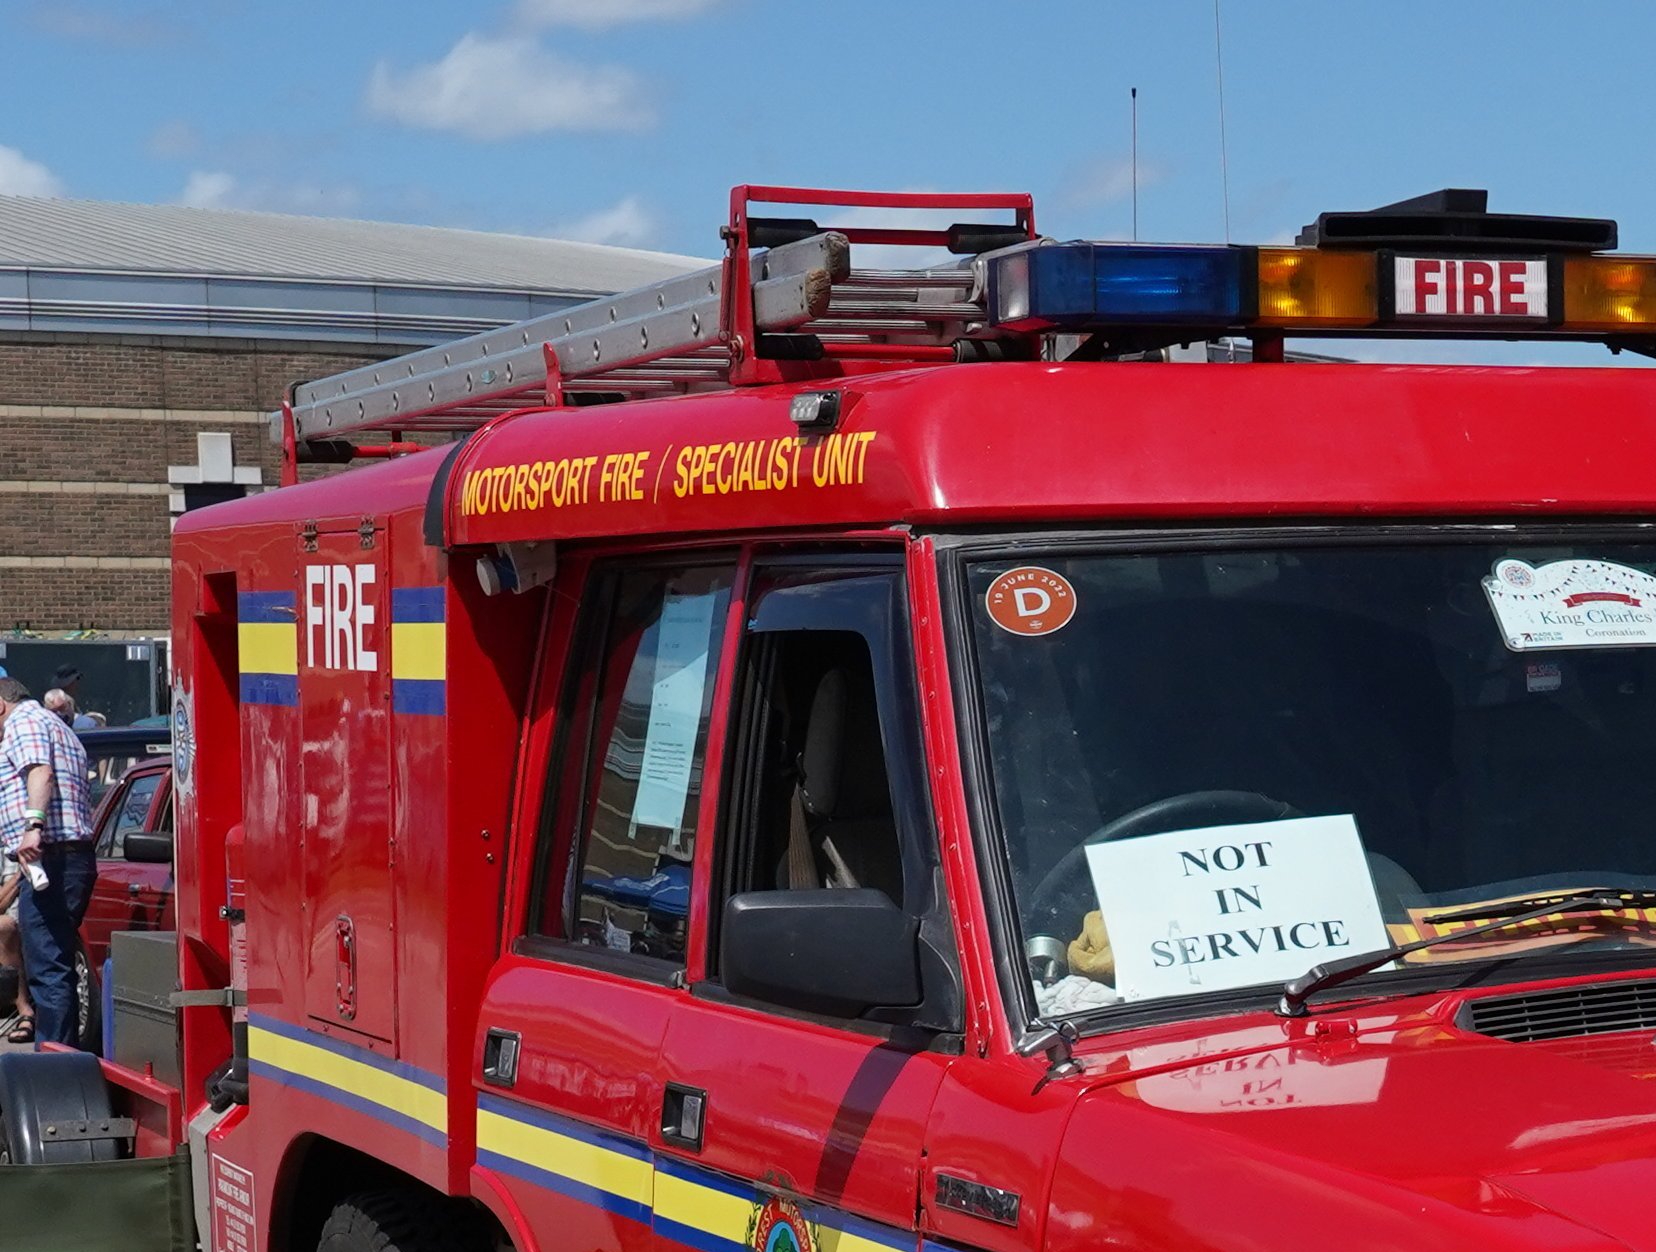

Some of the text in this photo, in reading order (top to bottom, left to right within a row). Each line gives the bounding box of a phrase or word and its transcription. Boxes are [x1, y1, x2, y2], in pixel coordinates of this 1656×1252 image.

[1415, 260, 1528, 314] FIRE
[462, 456, 598, 516] MOTORSPORT
[599, 451, 650, 502] FIRE
[673, 436, 809, 498] SPECIALIST
[812, 430, 877, 488] UNIT
[1001, 573, 1034, 590] JUNE
[1041, 576, 1067, 597] 2022
[306, 563, 377, 672] FIRE
[1014, 587, 1051, 616] D
[1540, 611, 1585, 626] King
[1586, 609, 1650, 624] Charles
[1585, 628, 1647, 638] Coronation
[1177, 841, 1273, 876] NOT
[1213, 885, 1264, 915] IN
[1150, 920, 1350, 968] SERVICE
